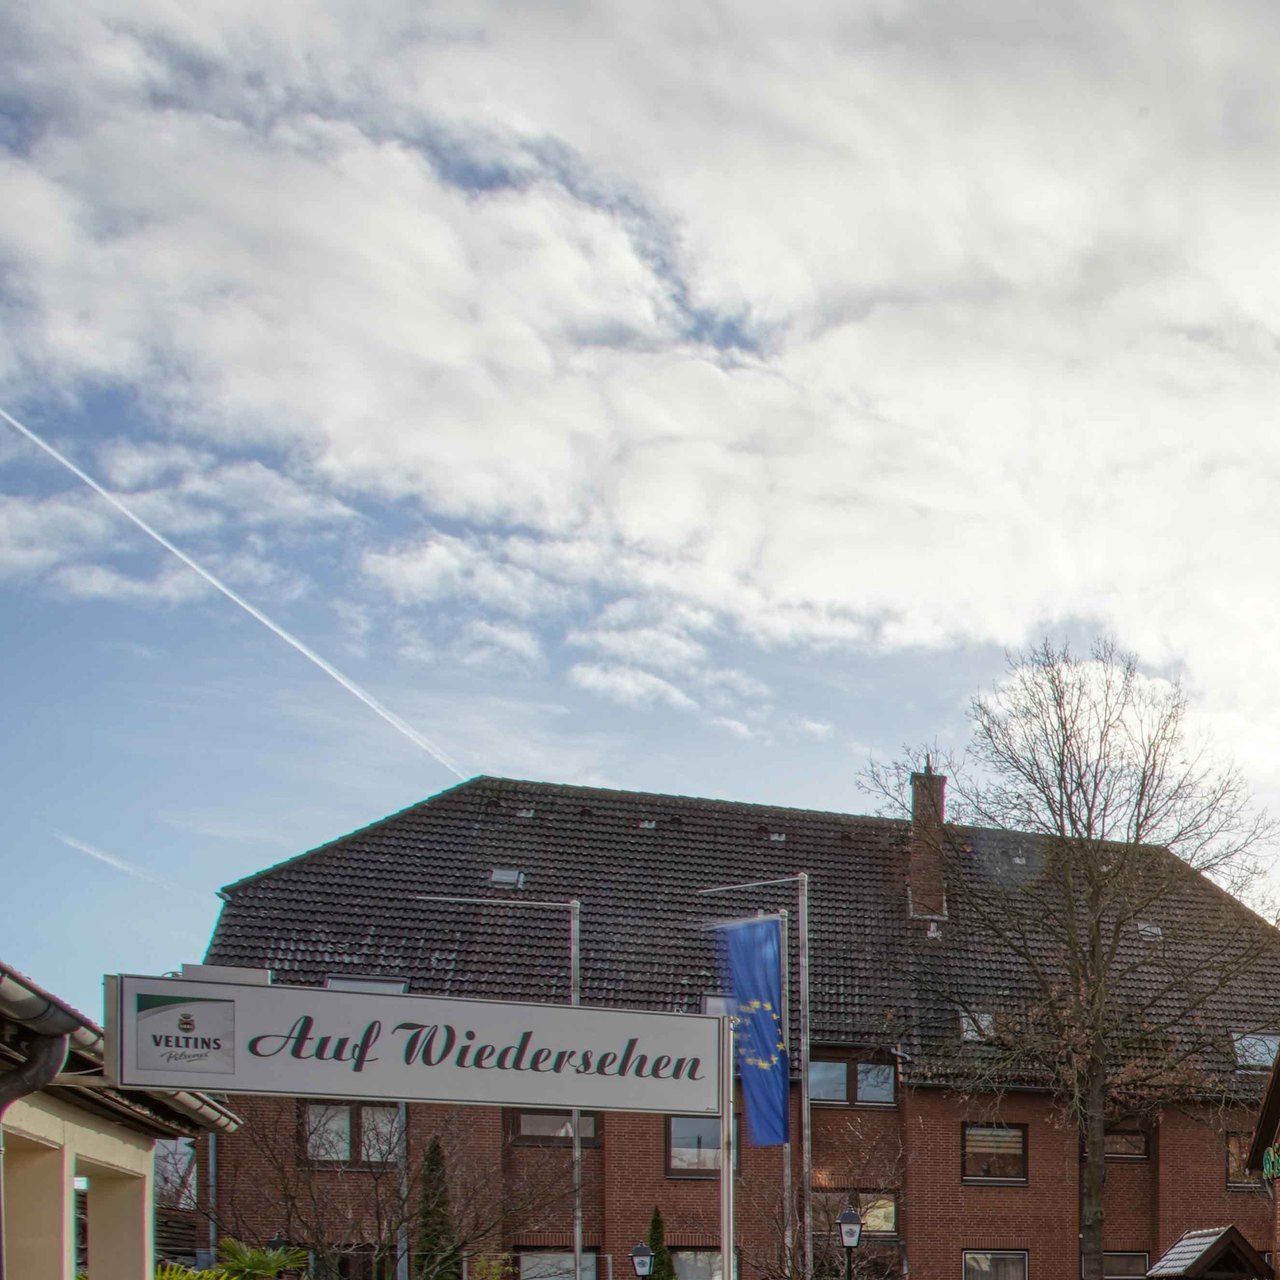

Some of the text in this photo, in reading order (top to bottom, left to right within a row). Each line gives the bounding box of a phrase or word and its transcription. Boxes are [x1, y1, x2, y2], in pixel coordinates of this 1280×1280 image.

[152, 1034, 222, 1050] VELTINS
[248, 1015, 706, 1082] Auf Wiedersehen
